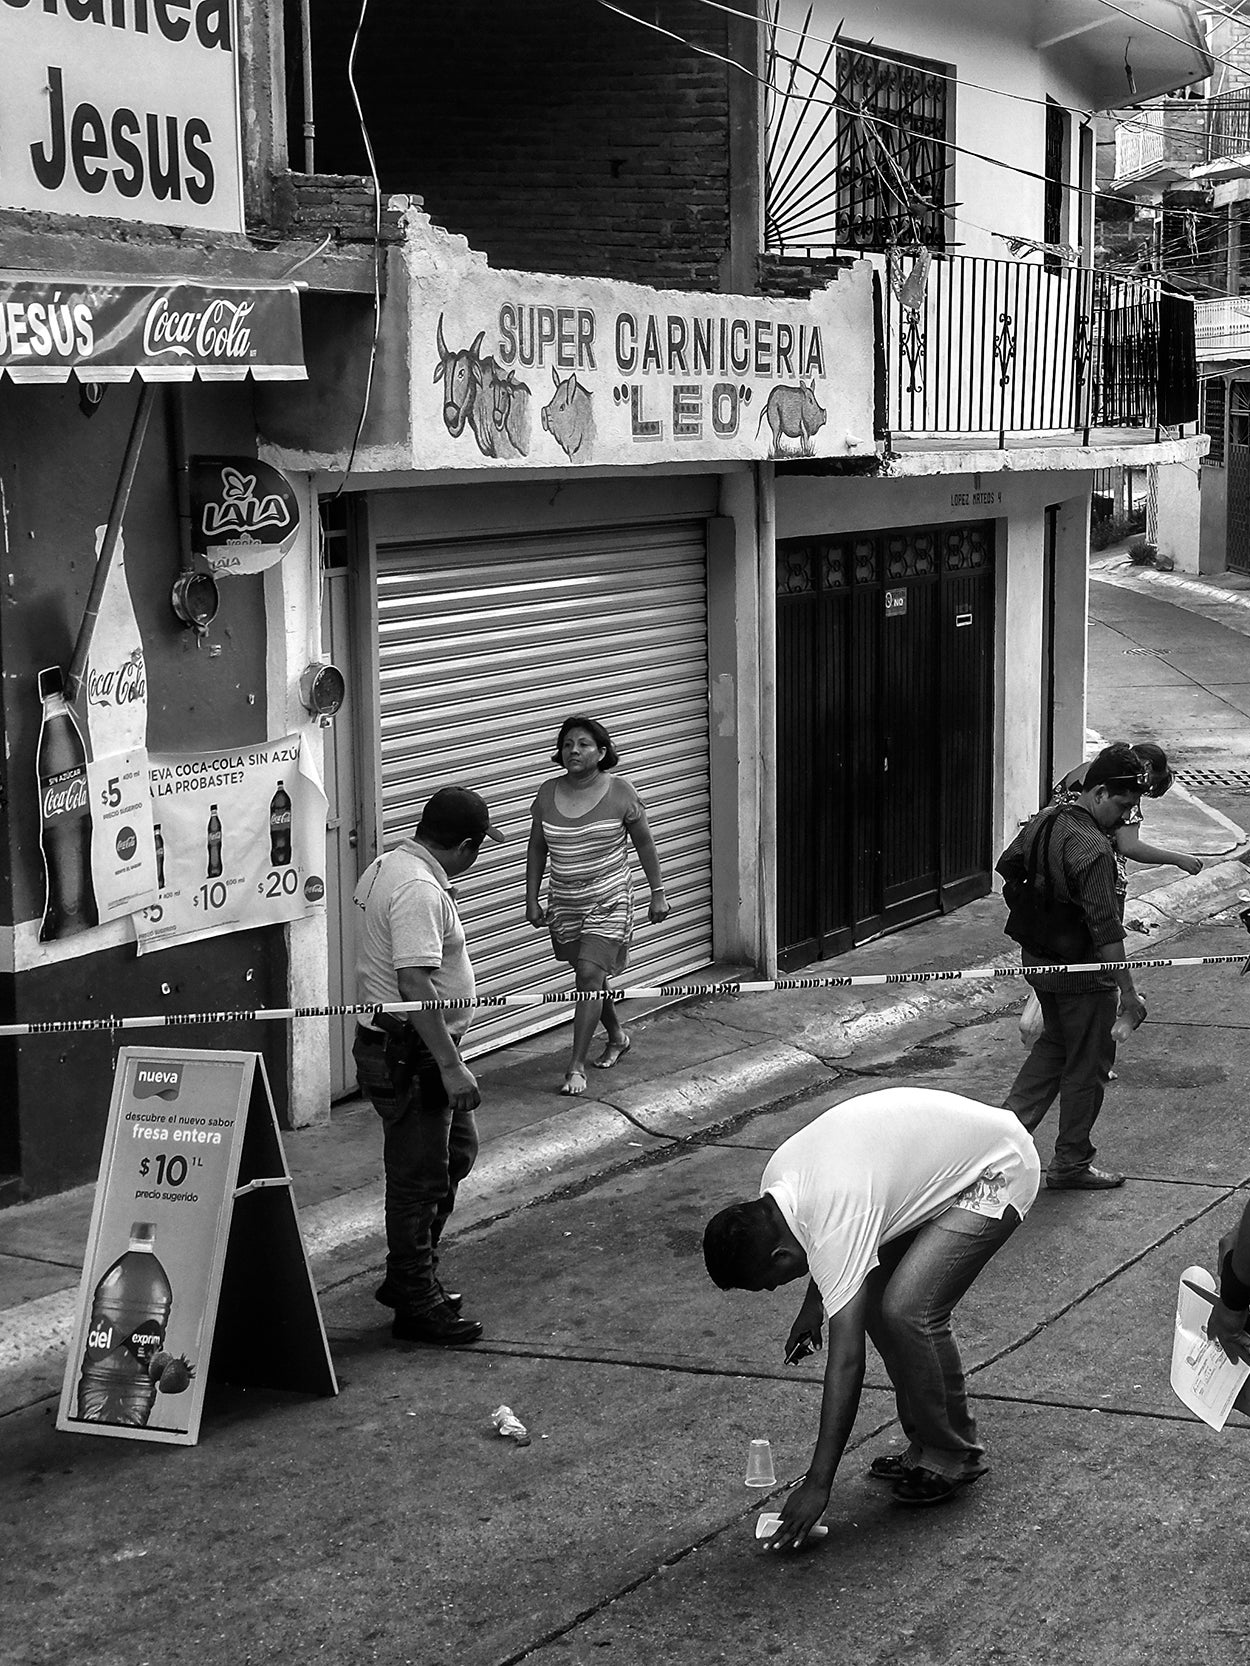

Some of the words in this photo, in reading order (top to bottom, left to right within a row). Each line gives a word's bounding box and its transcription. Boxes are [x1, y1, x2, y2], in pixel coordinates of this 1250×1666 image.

[29, 66, 214, 205] Jesus
[143, 297, 255, 358] Coca-Cola
[499, 302, 597, 371] SUPER
[614, 312, 827, 379] CARNICERIA
[950, 493, 970, 506] LOPEZ
[149, 768, 173, 783] EVA
[175, 756, 245, 777] COCA-COLA
[248, 752, 268, 766] SIN
[272, 746, 300, 763] AZÚ
[101, 777, 121, 808] $5
[158, 783, 173, 797] LA
[175, 771, 245, 794] PROBASTE?
[193, 881, 227, 911] $10
[257, 868, 298, 899] $20
[138, 1070, 178, 1084] nueva
[125, 1111, 166, 1123] descubre
[168, 1115, 177, 1124] el
[178, 1118, 206, 1126] nuevo
[207, 1117, 235, 1128] sabor
[132, 1123, 169, 1140] fresa
[173, 1128, 222, 1145] entera
[135, 1189, 161, 1200] precio
[162, 1191, 199, 1203] sugerido
[88, 1320, 113, 1350] ciel
